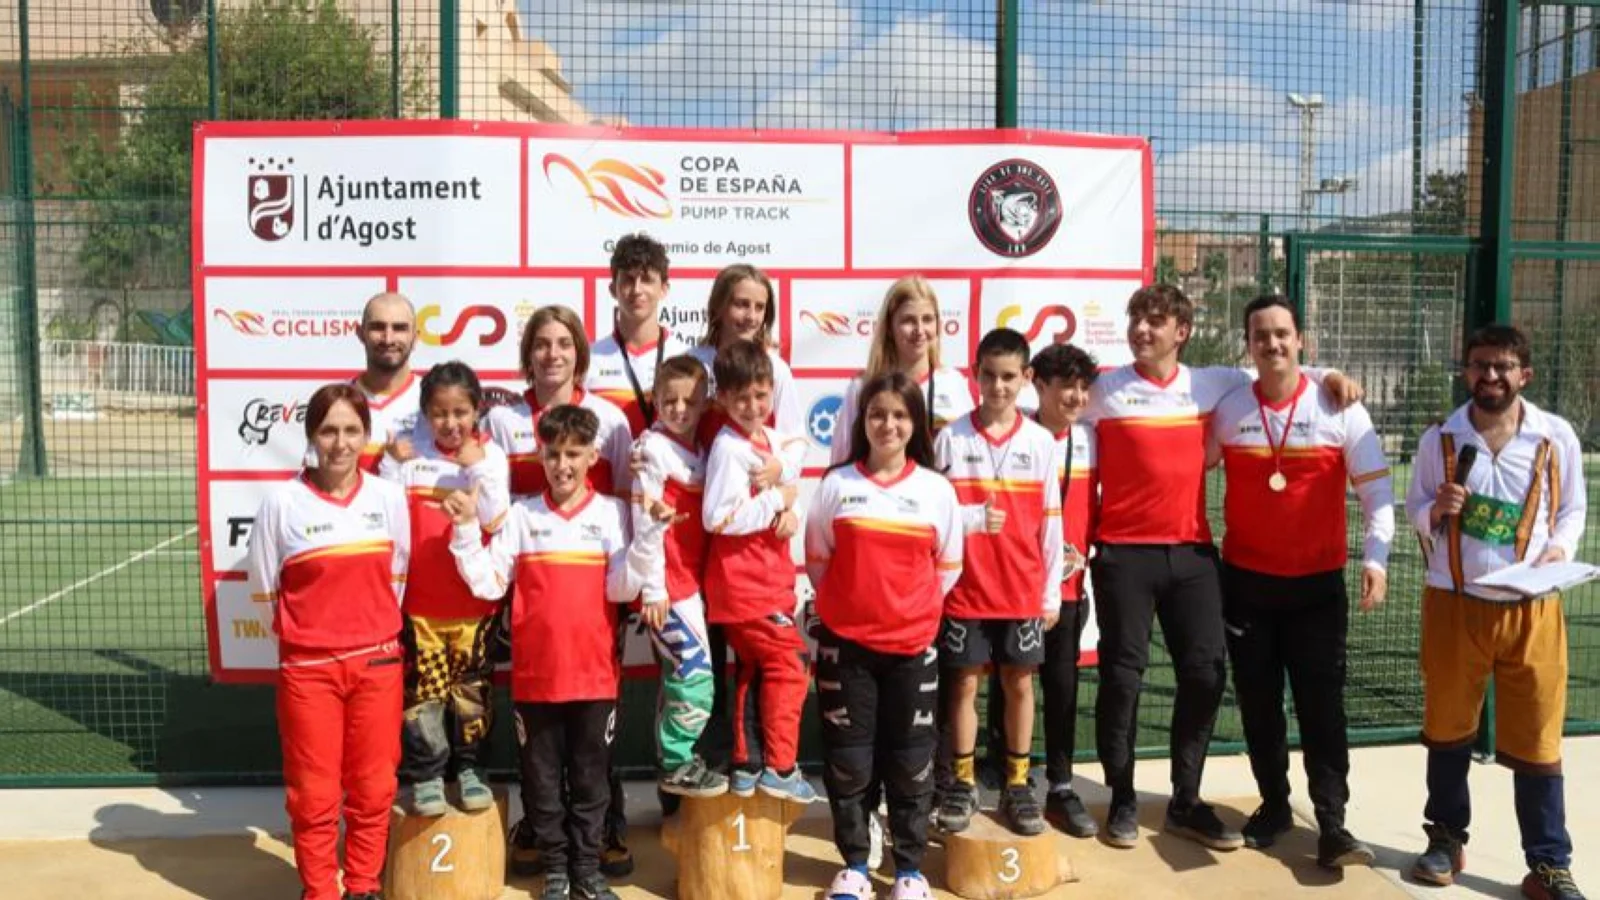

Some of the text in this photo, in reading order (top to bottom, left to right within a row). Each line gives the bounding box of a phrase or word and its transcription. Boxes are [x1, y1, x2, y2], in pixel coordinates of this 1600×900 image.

[680, 156, 740, 172] COPA
[317, 174, 482, 207] Ajuntament
[680, 175, 802, 194] DE ESPAÑA
[681, 206, 791, 220] PUMP TRACK
[662, 240, 771, 257] emio de Agost
[272, 319, 358, 337] CICLISM
[730, 812, 751, 852] 1
[430, 833, 454, 873] 2
[999, 849, 1022, 883] 3
